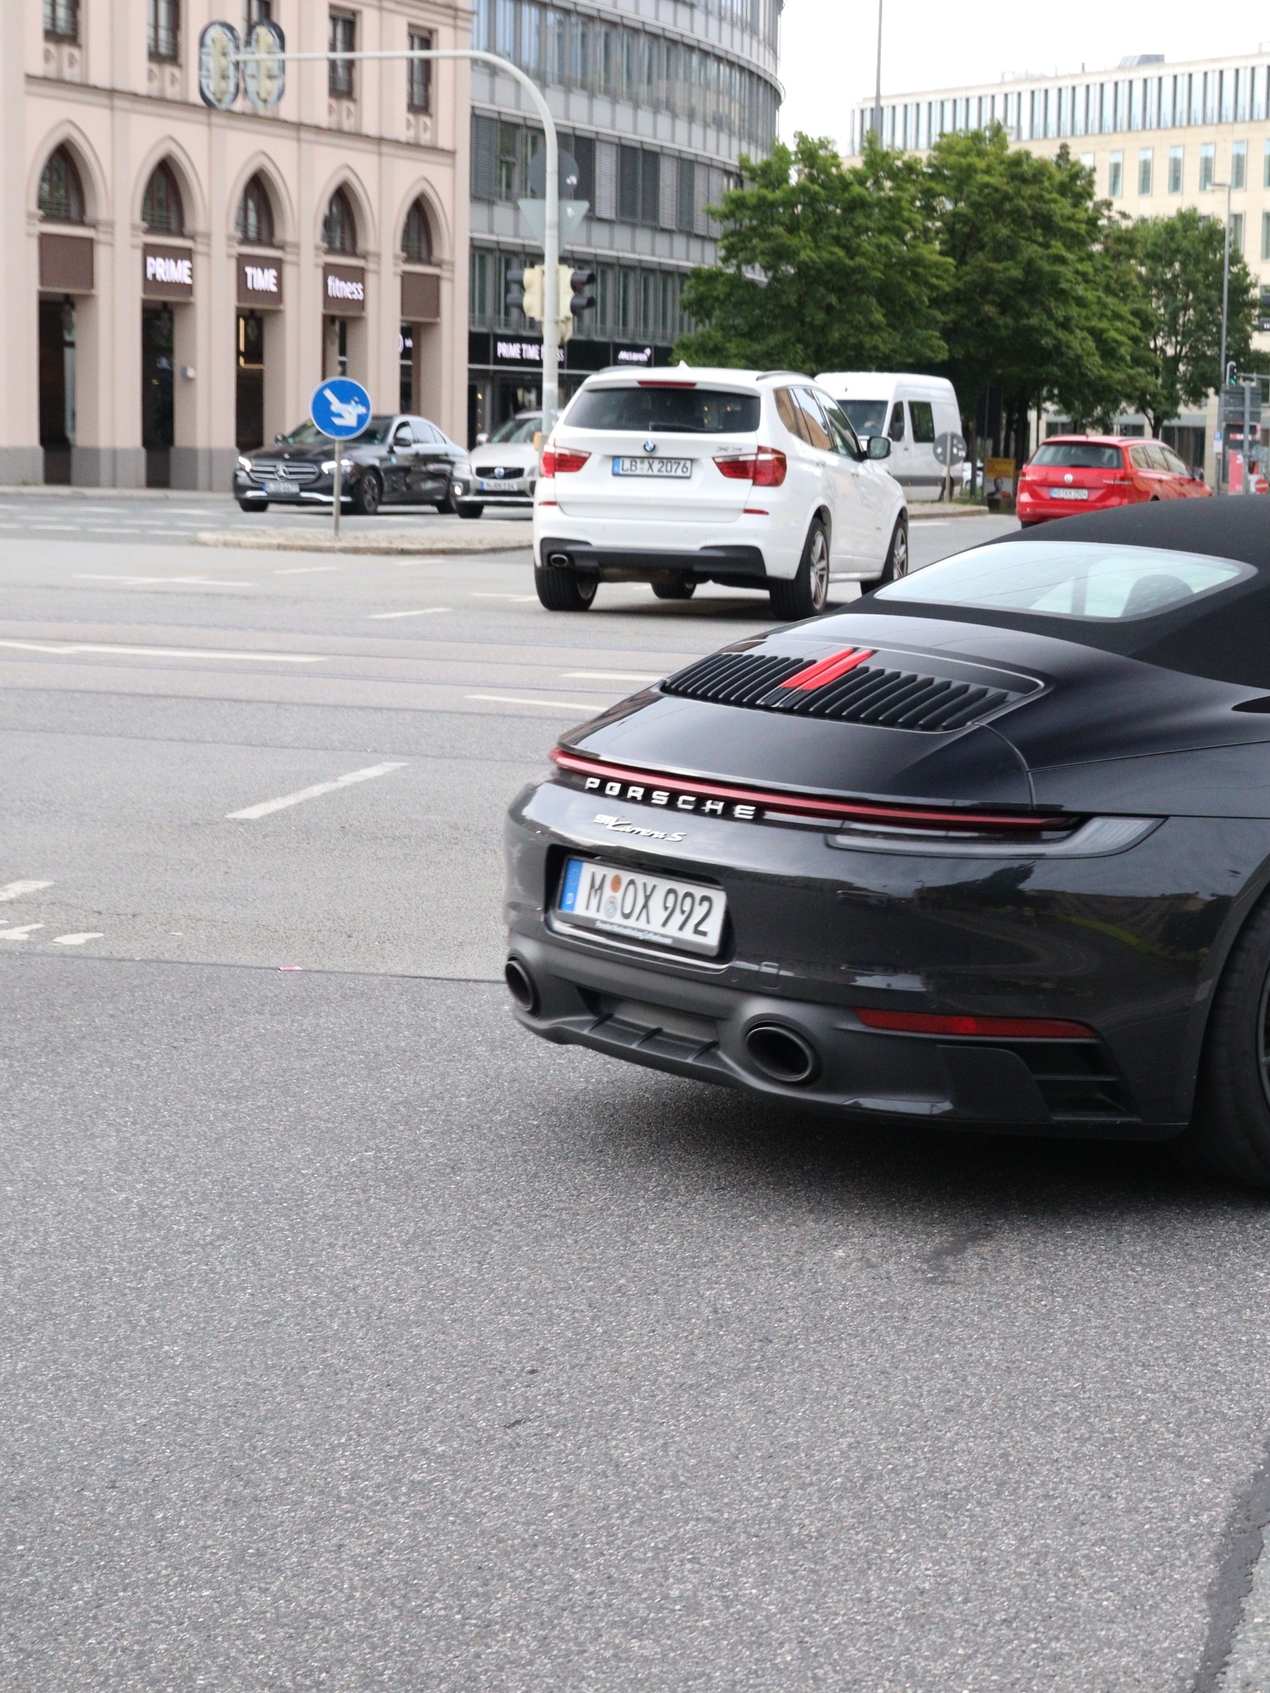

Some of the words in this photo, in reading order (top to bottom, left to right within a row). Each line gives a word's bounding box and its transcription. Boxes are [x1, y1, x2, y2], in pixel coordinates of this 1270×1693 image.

[146, 256, 193, 285] PRIME
[245, 266, 278, 292] TIME
[327, 275, 364, 300] fitness
[497, 341, 521, 360] PRIME
[522, 343, 541, 361] TIME
[621, 459, 638, 473] LB
[646, 460, 655, 474] X
[657, 461, 689, 475] 2076
[585, 777, 757, 820] PORSCHE
[585, 870, 607, 913] M
[620, 877, 658, 925] OX
[661, 887, 714, 938] 992
